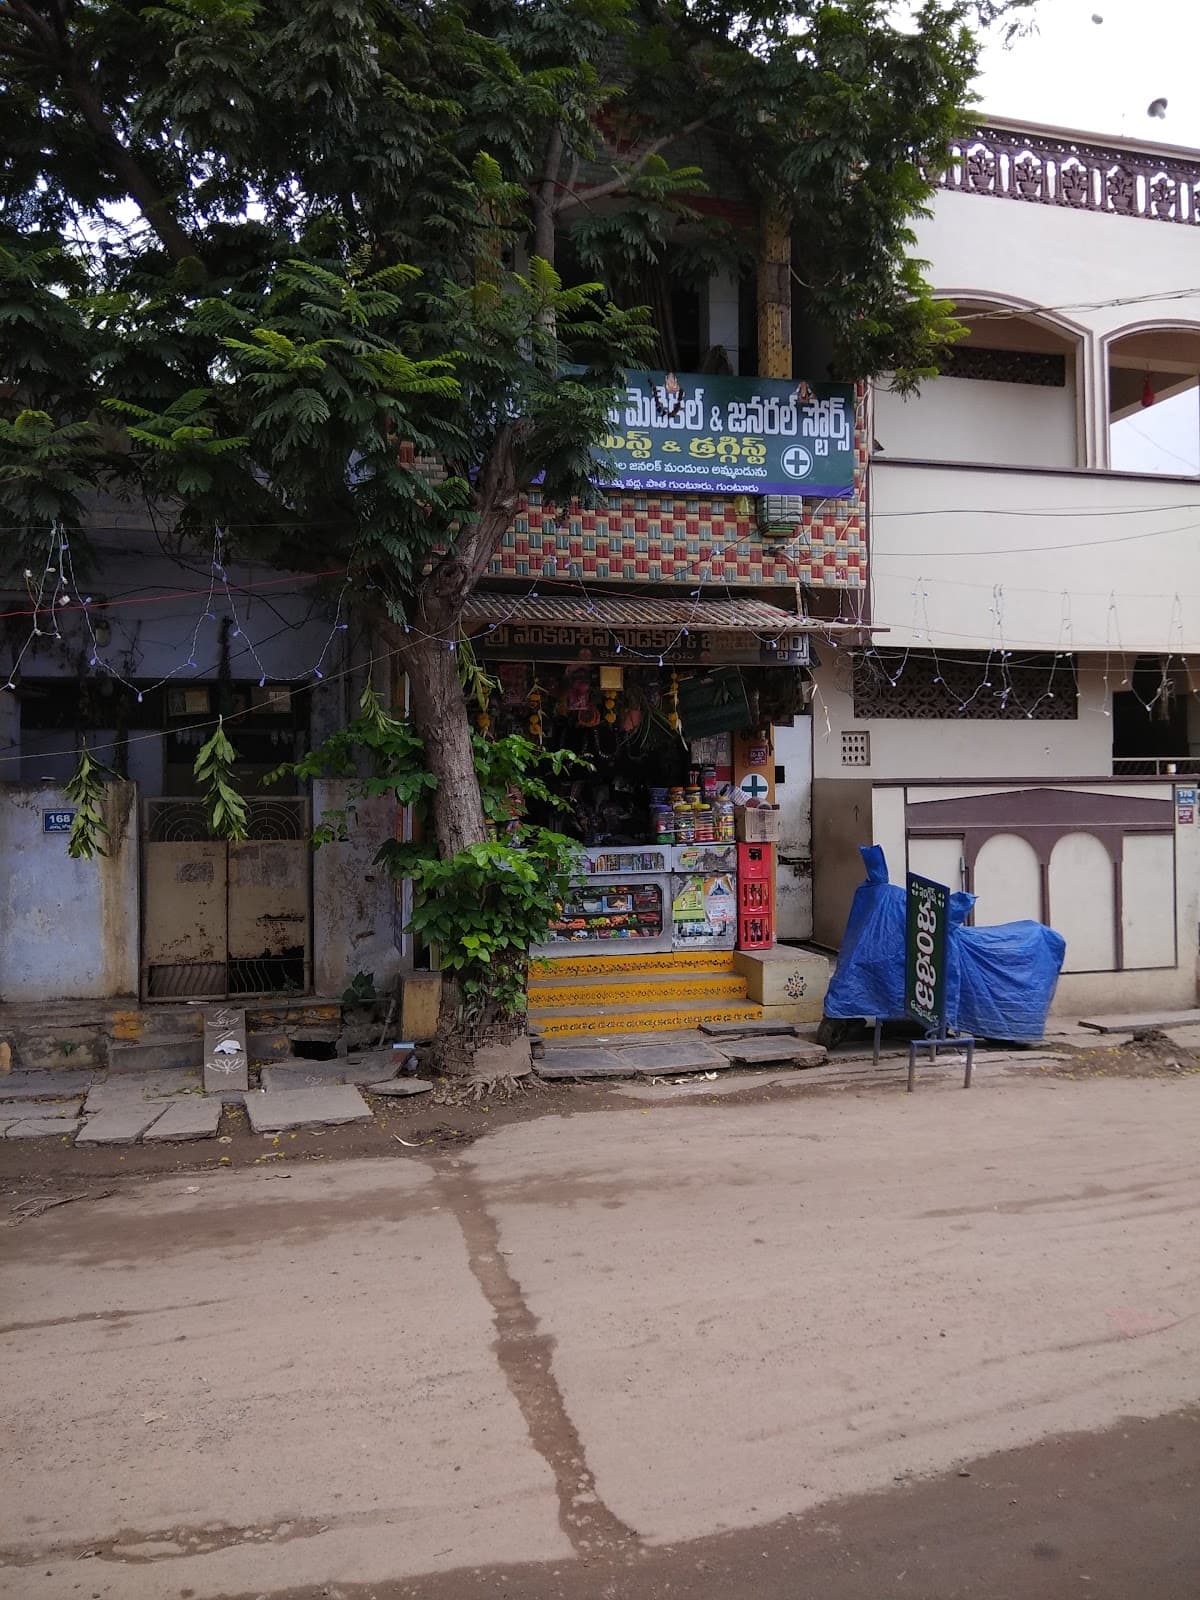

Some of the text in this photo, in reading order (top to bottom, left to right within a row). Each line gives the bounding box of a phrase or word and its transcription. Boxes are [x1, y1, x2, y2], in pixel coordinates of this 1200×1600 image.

[709, 406, 724, 432] &
[727, 395, 798, 436] జనరల్
[802, 396, 850, 456] స్టోర్స్
[661, 440, 682, 453] &
[664, 462, 709, 474] మందులు
[711, 464, 768, 479] అమ్మబడును
[49, 814, 71, 823] 168
